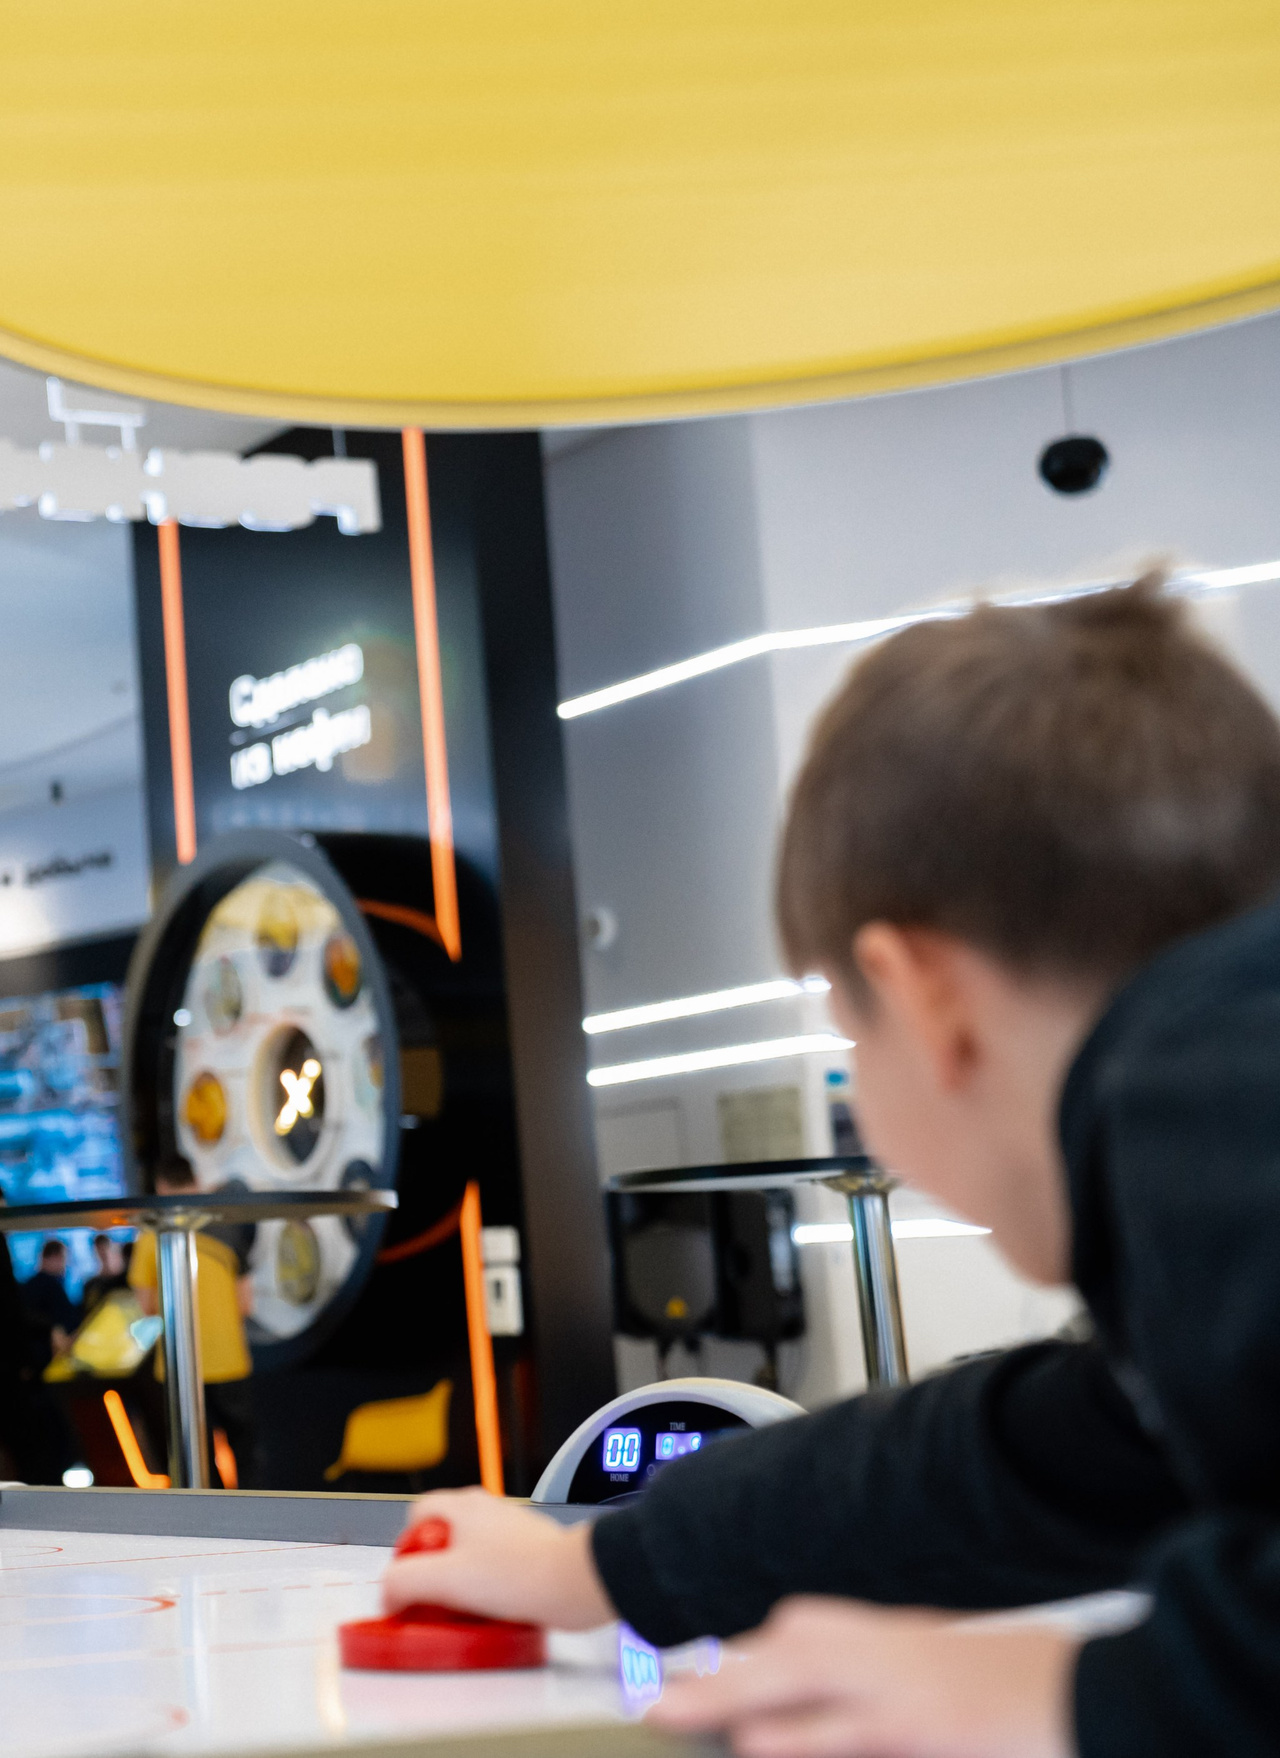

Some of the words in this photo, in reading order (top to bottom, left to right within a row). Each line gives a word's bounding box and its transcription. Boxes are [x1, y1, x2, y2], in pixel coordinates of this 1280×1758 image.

[669, 1422, 686, 1431] TIME
[605, 1432, 640, 1468] 00
[610, 1473, 629, 1482] HOME
